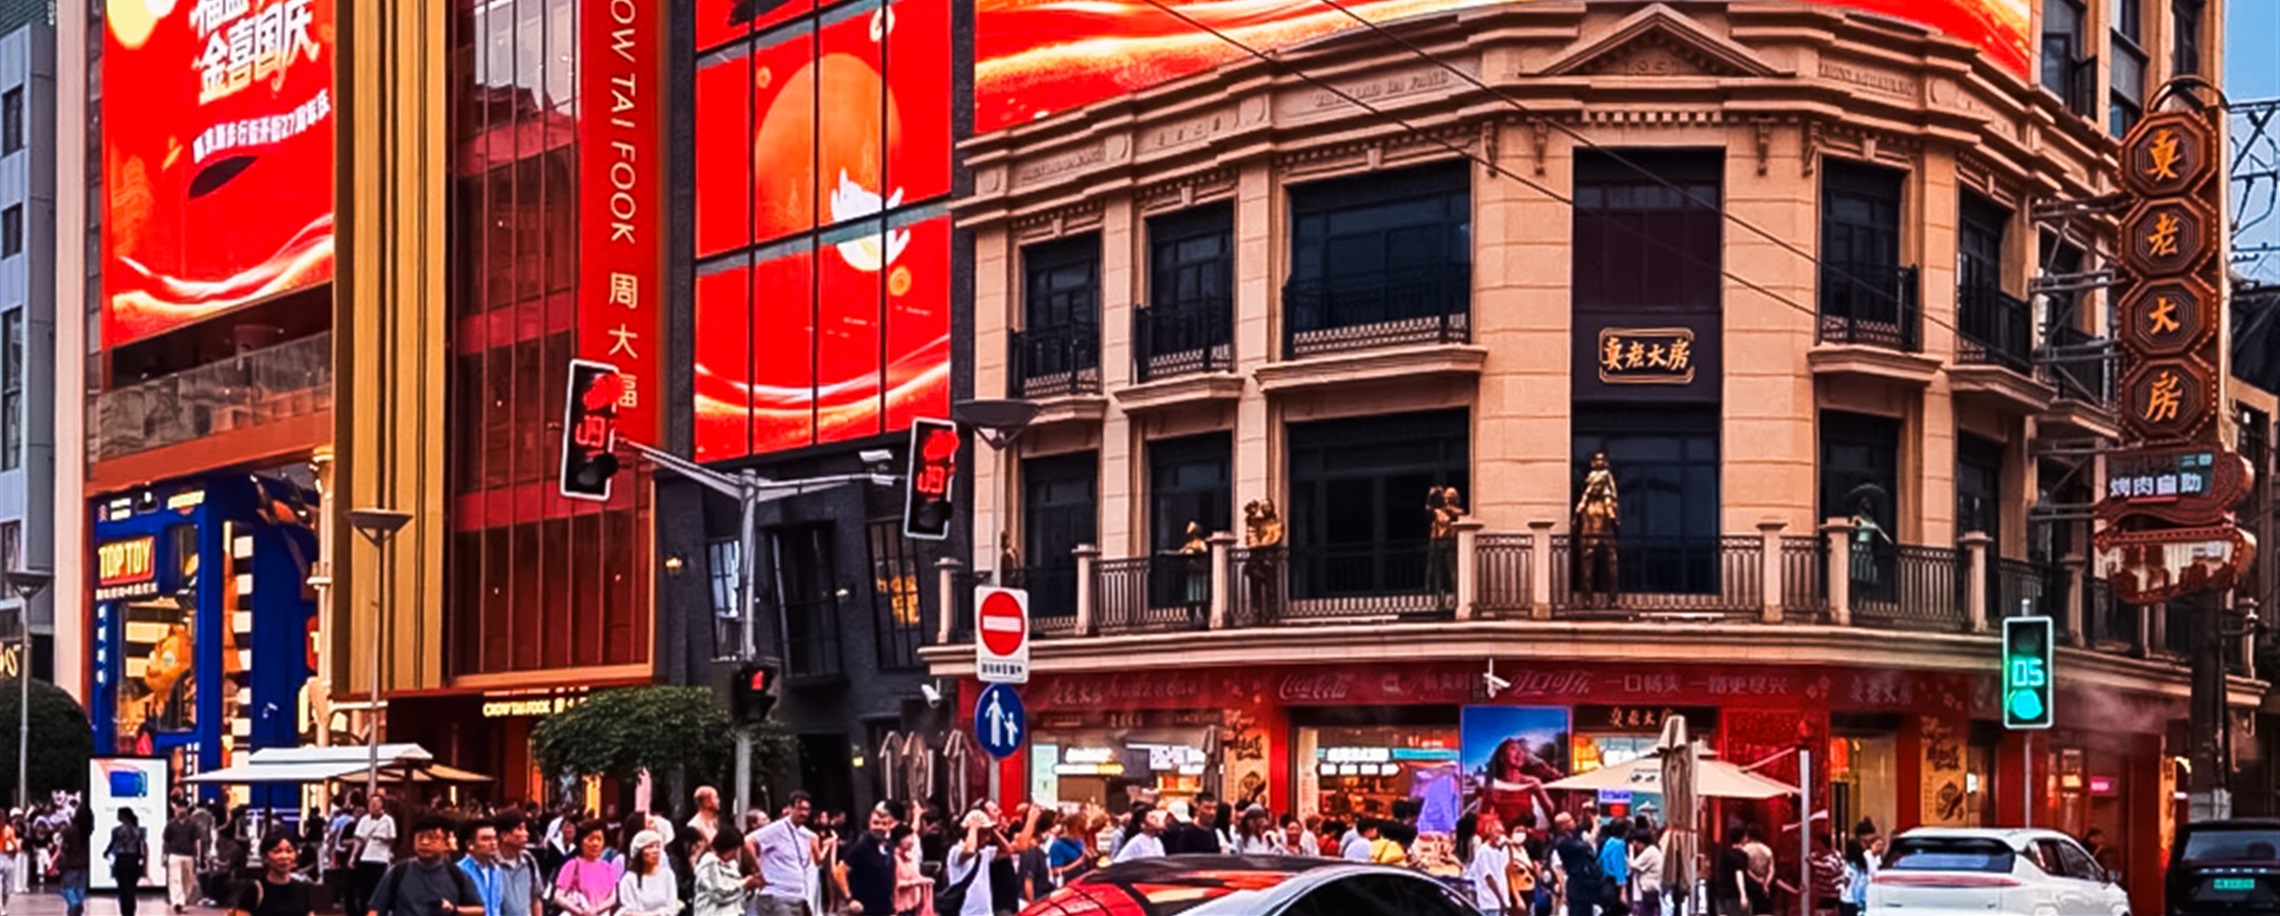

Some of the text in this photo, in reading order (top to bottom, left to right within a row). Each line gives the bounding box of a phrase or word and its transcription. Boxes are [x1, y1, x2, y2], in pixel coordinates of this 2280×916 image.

[192, 1, 319, 106] 金喜国庆
[611, 73, 635, 128] TAI
[610, 141, 636, 241] FOOK
[2110, 472, 2202, 497] 烤肉自助
[98, 536, 153, 580] TOP TOY
[2012, 659, 2045, 687] 05
